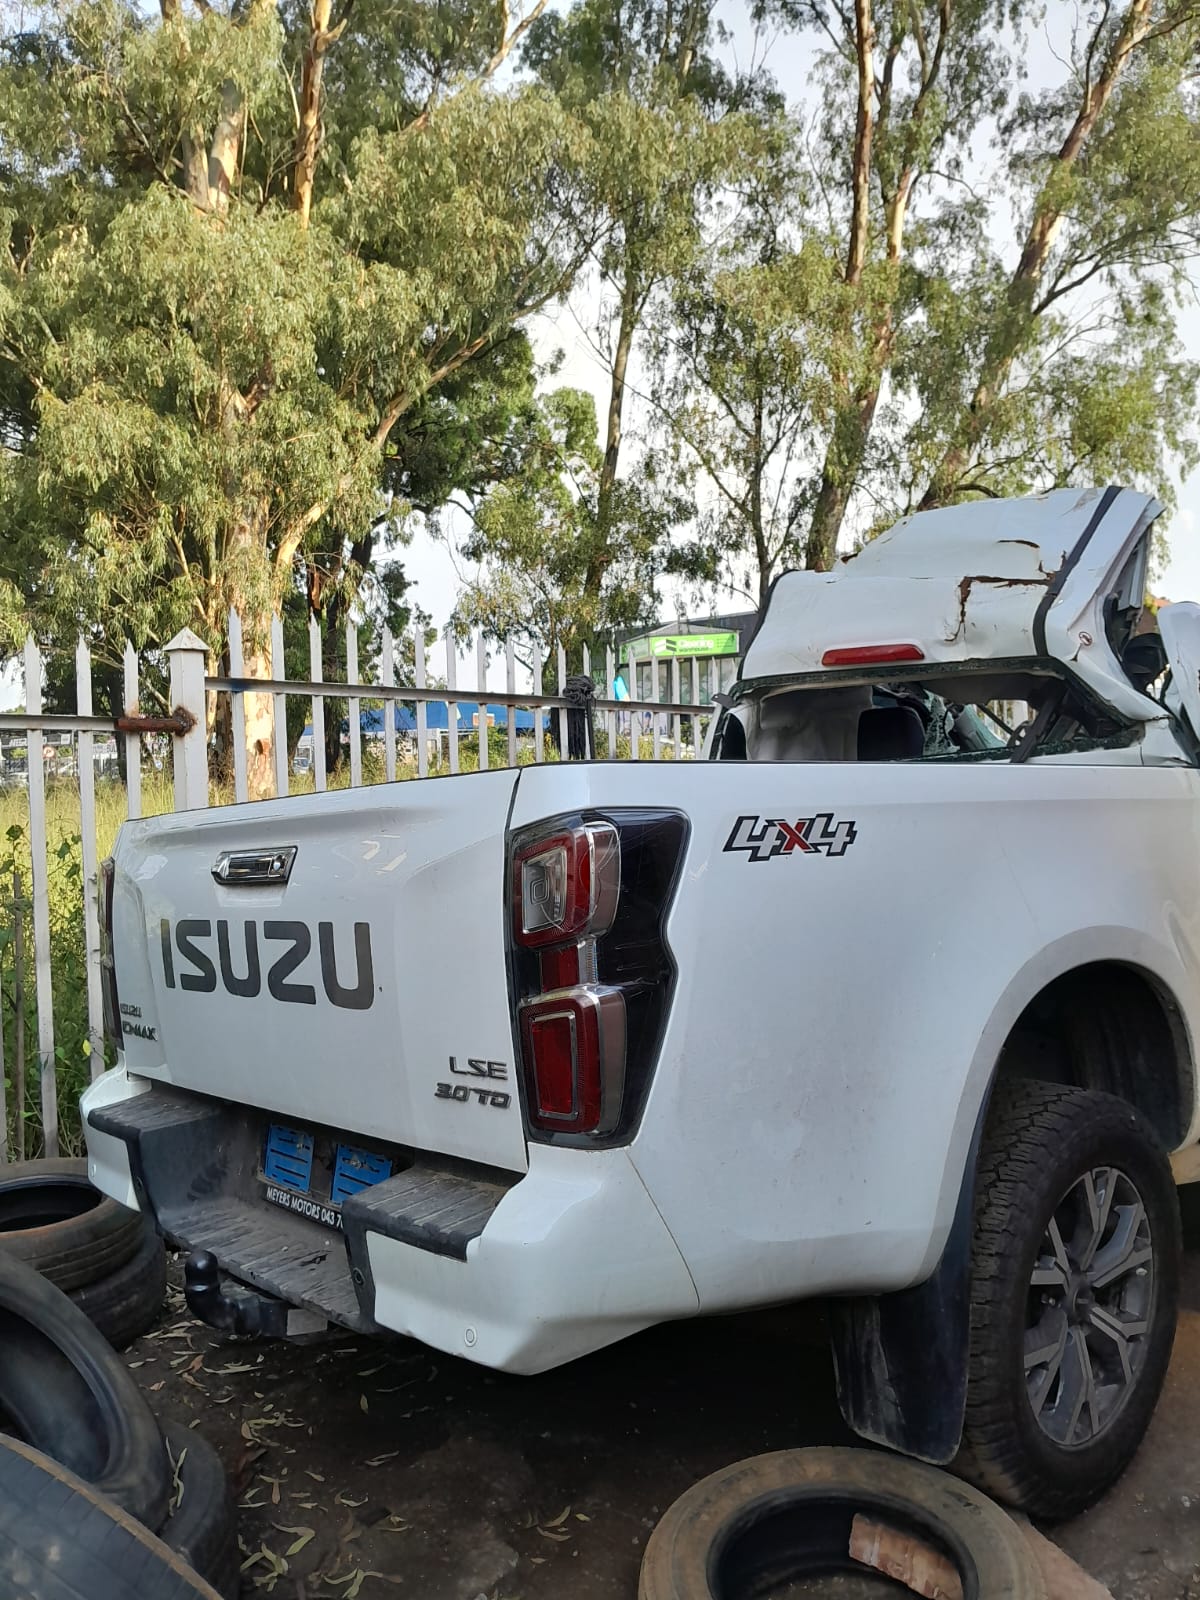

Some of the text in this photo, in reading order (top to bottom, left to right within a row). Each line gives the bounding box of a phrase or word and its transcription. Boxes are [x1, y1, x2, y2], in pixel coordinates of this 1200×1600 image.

[160, 918, 375, 1010] ISUZU
[448, 1056, 509, 1081] LSE
[266, 1186, 291, 1207] MEYERS
[290, 1196, 320, 1220] MOTORS
[321, 1208, 335, 1226] 043
